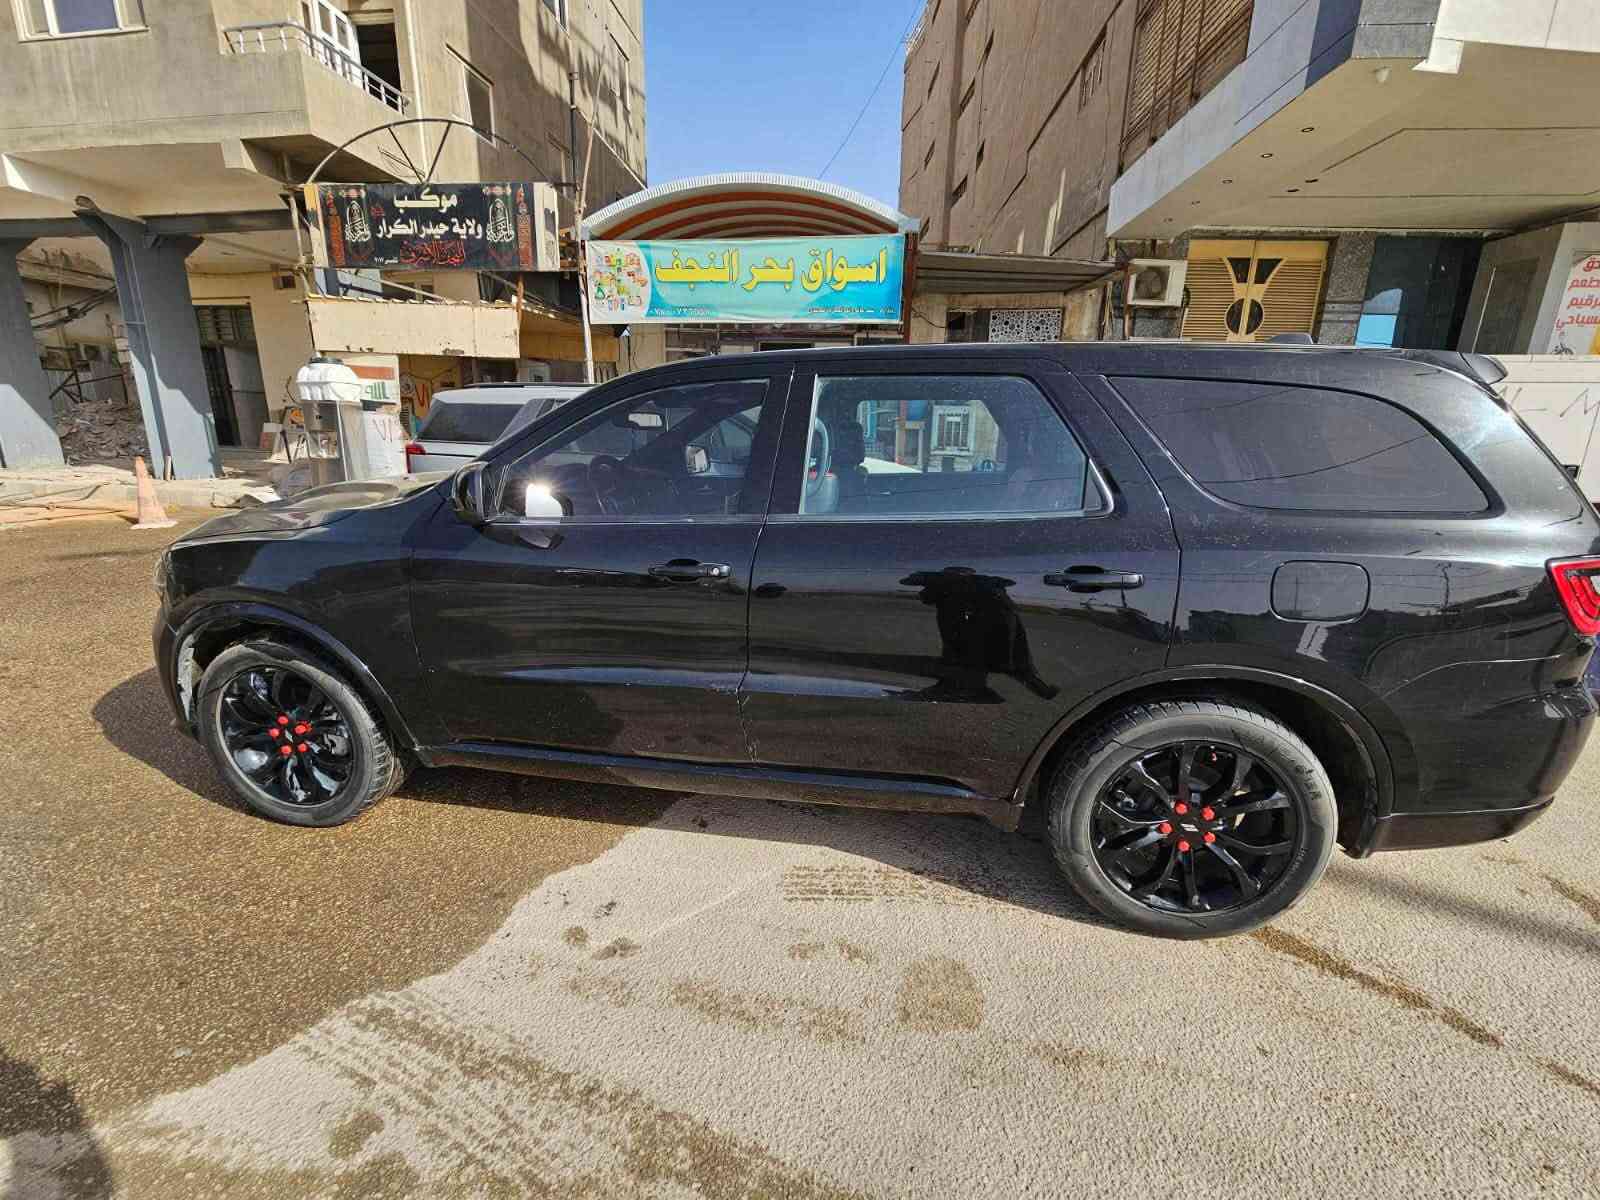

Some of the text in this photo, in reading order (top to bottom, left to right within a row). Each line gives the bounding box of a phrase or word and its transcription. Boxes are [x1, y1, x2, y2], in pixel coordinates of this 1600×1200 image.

[393, 187, 458, 213] موكب
[376, 218, 418, 239] الكرار
[419, 219, 449, 239] حيدر
[451, 217, 483, 239] ولاية
[654, 246, 888, 293] اسواق بحر النجف
